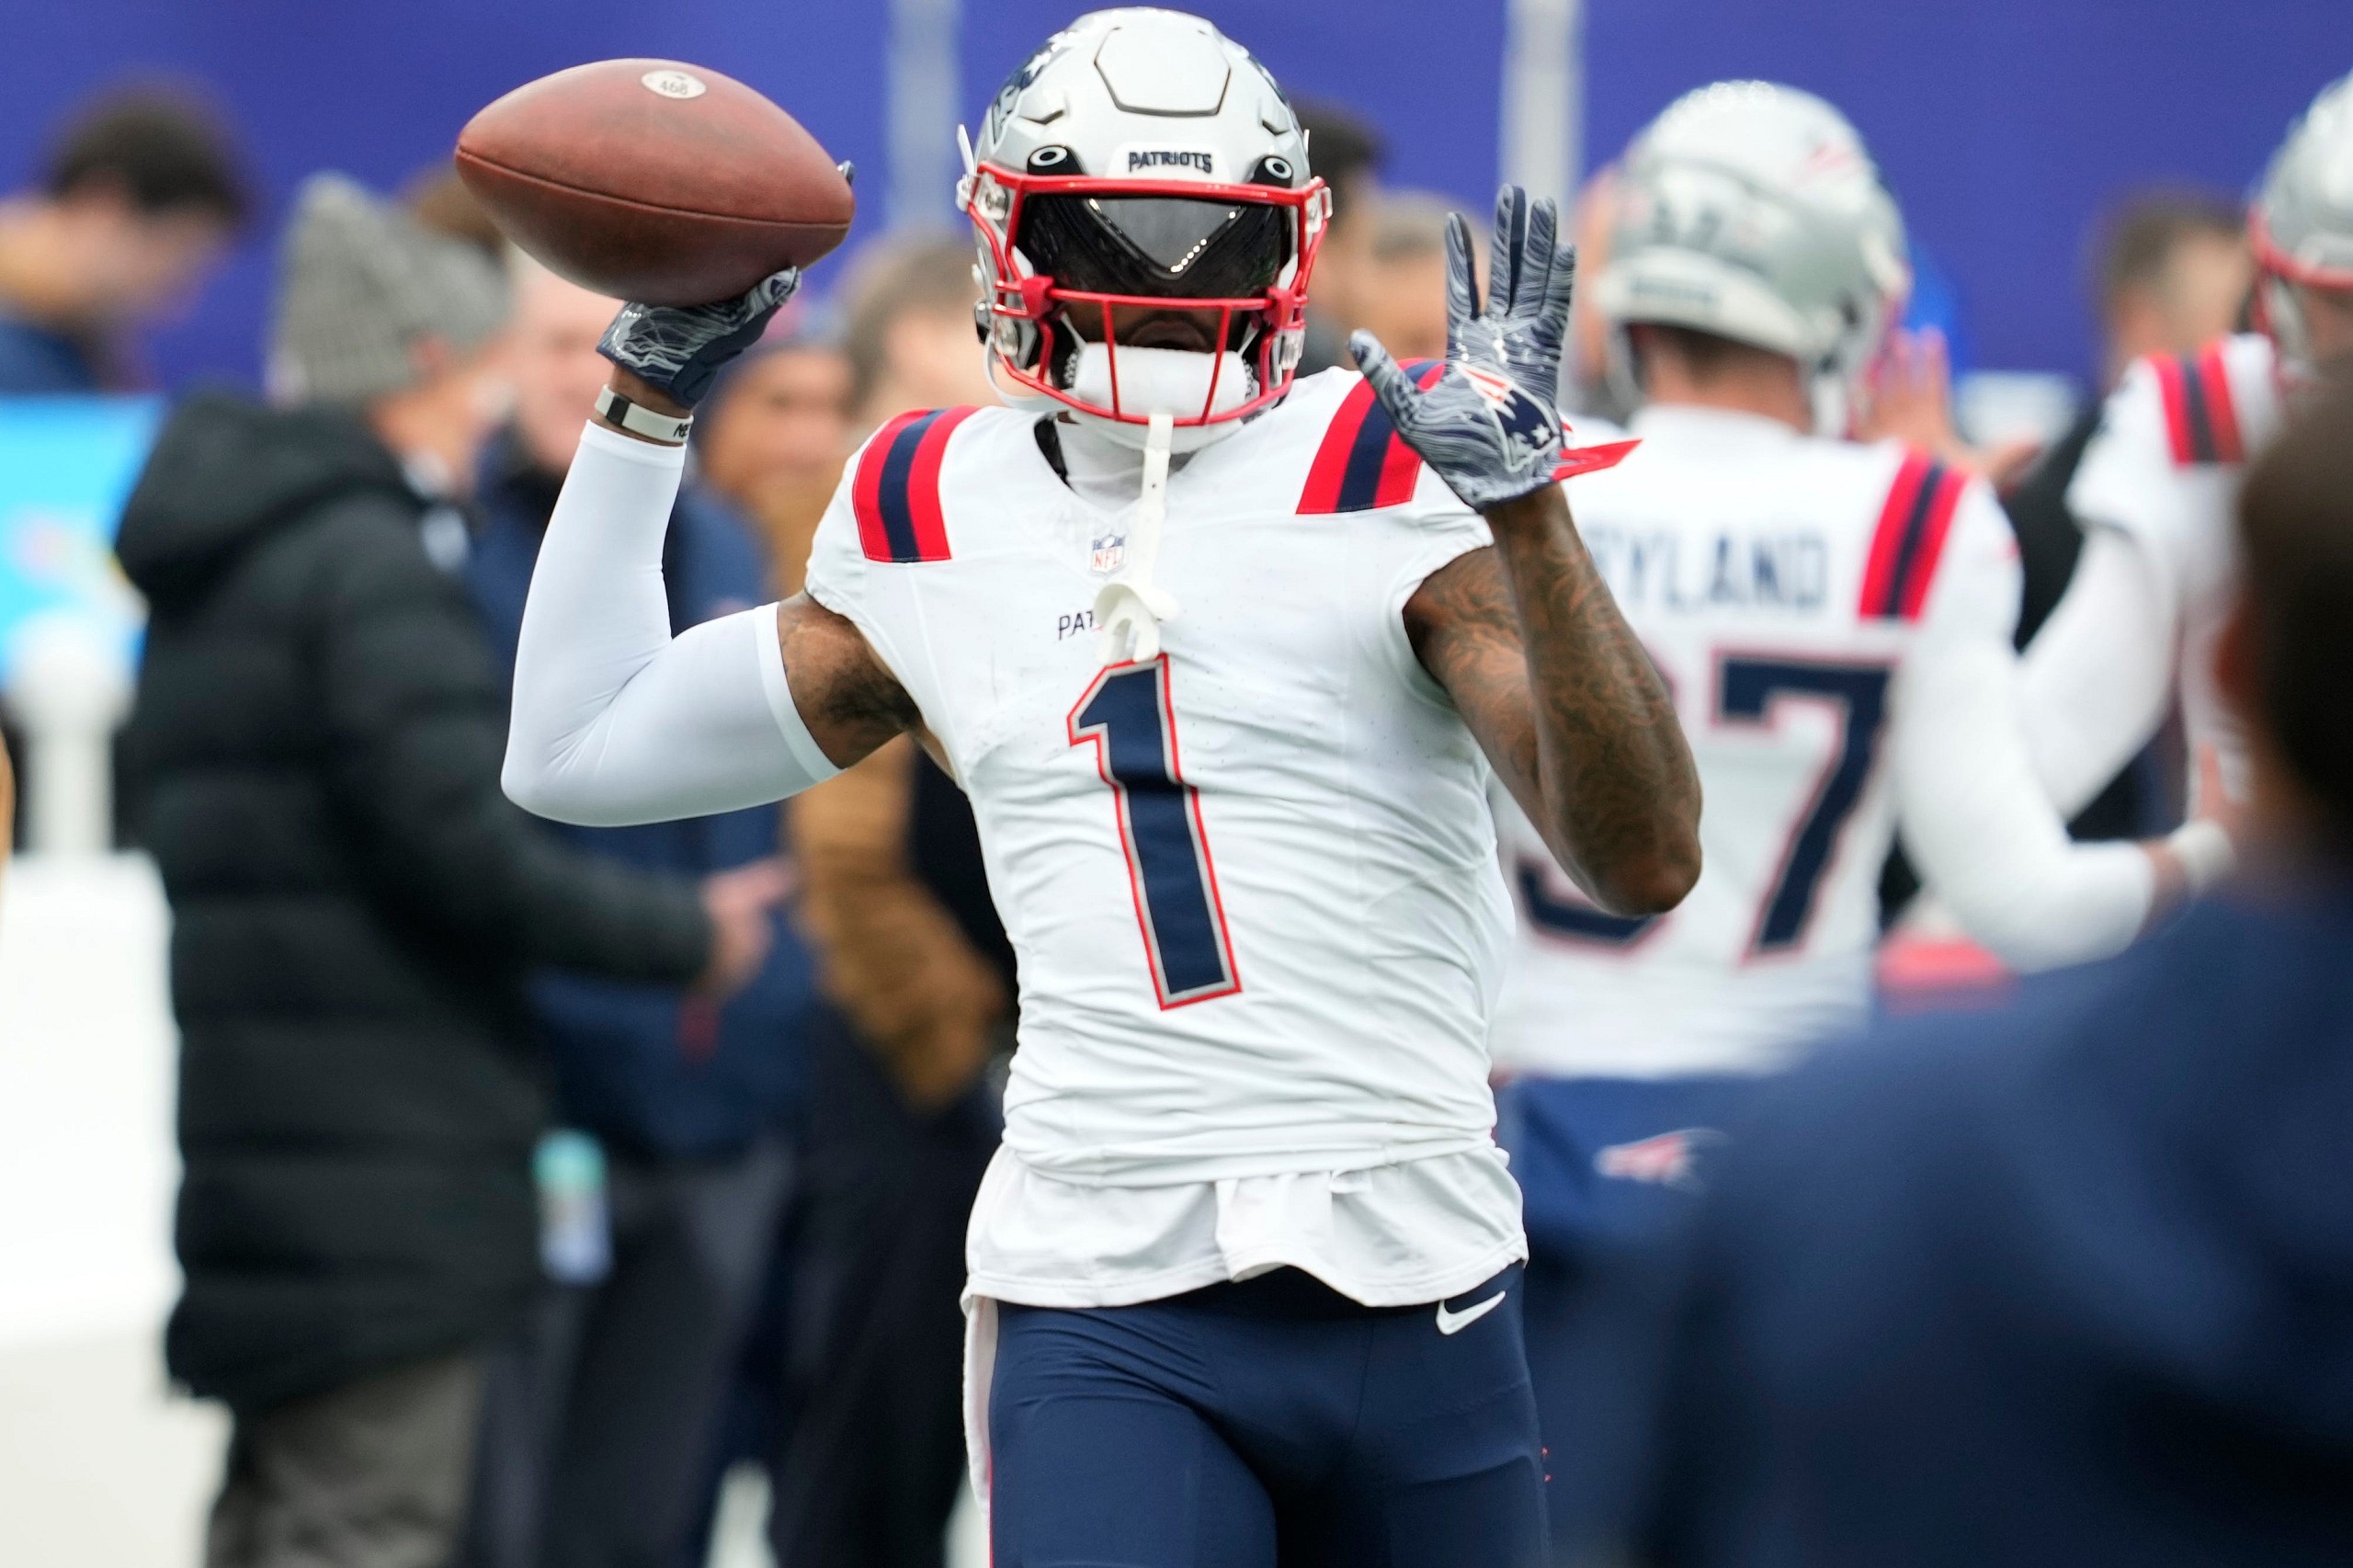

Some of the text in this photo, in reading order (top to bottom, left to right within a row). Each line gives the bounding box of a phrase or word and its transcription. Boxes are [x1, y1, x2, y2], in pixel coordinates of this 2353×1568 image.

[1128, 151, 1212, 174] PATRIOTS
[1093, 548, 1120, 569] NFL
[1067, 653, 1244, 1011] 1
